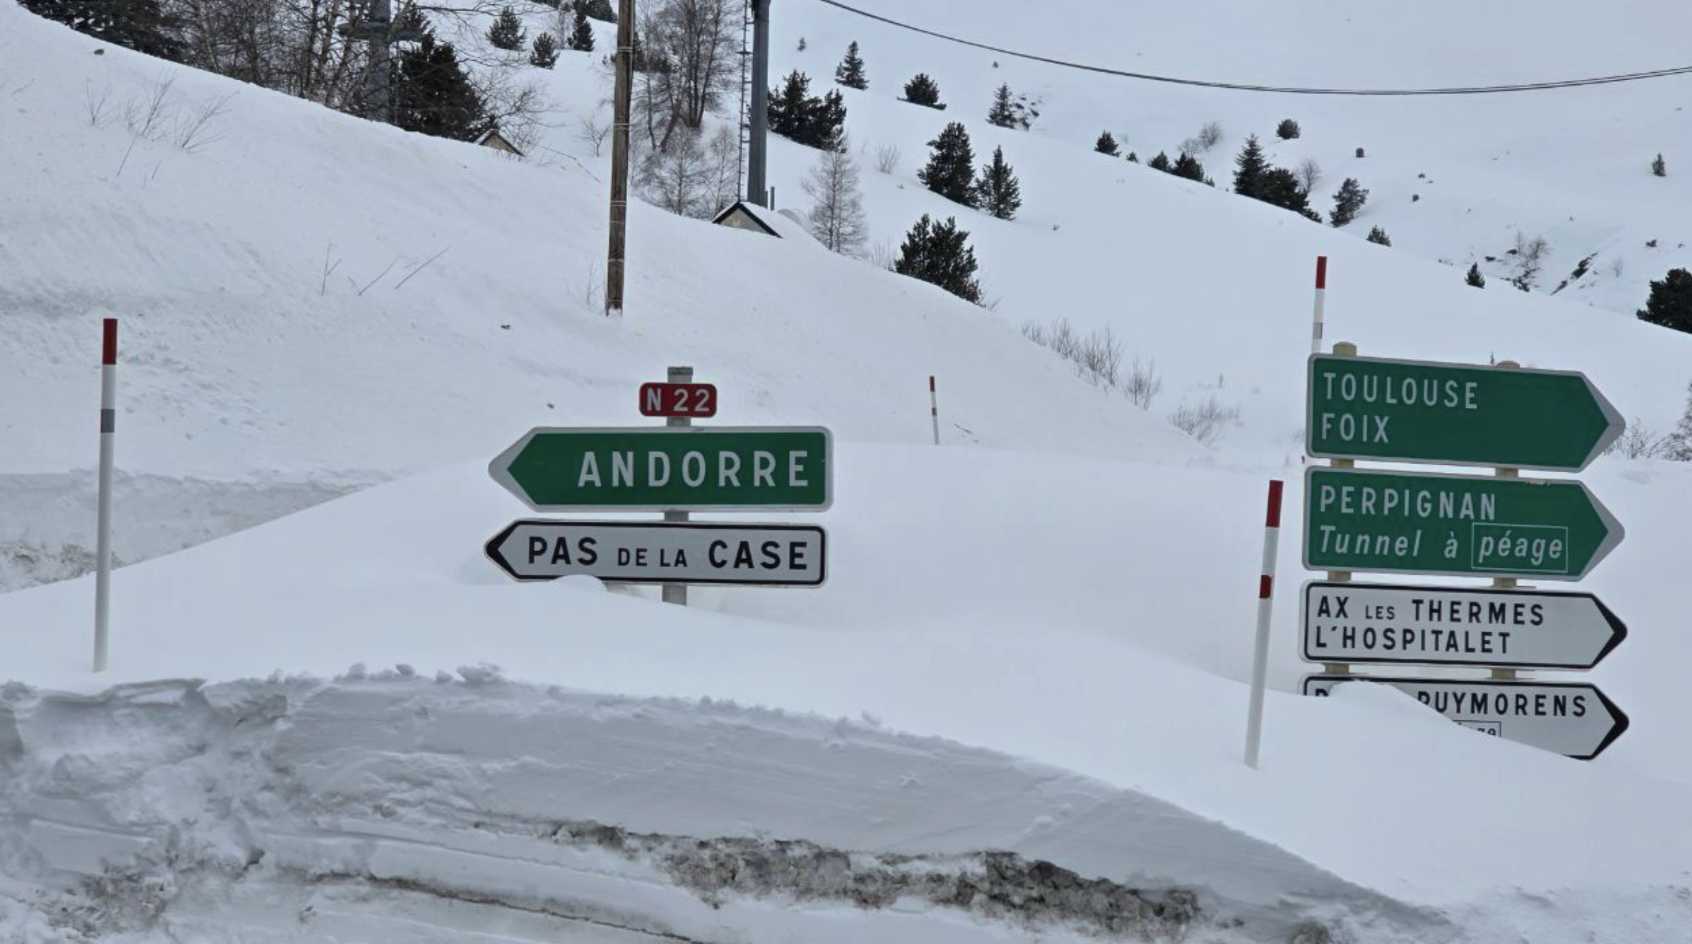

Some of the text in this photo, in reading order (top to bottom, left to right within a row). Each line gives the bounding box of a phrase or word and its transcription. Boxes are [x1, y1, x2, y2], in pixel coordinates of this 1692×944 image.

[646, 387, 710, 412] N 22
[1323, 371, 1478, 409] TOULOUSE
[1321, 413, 1390, 443] FOIX
[577, 450, 809, 487] ANDORRE
[1319, 484, 1496, 521] PERPIGNAN
[528, 536, 808, 570] PAS DE LA CASE
[1319, 525, 1563, 566] Tunnel à péage
[1317, 595, 1545, 626] AX LES THERMES
[1315, 625, 1511, 654] L'HOSPITALET
